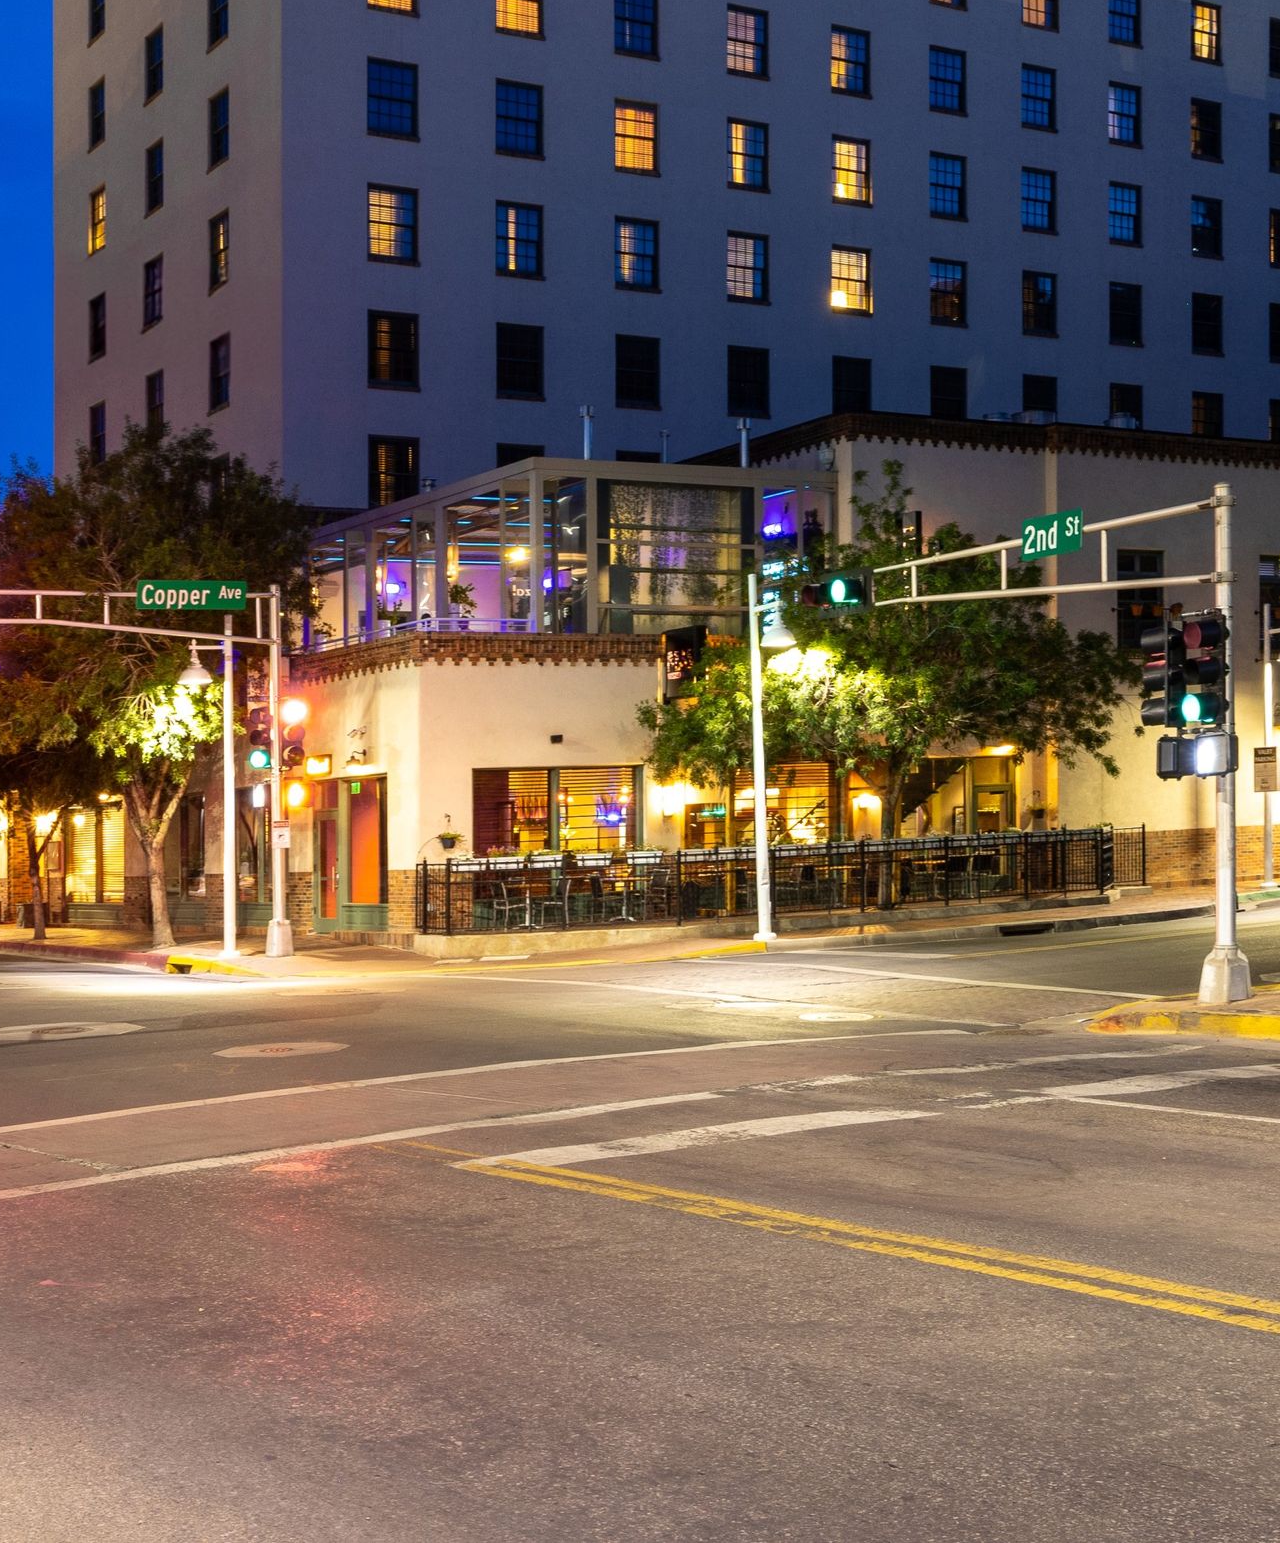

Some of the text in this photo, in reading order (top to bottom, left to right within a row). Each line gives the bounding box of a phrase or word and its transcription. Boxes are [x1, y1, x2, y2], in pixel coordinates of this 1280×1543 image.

[1024, 516, 1080, 555] 2nd St
[141, 584, 242, 609] Copper Ave
